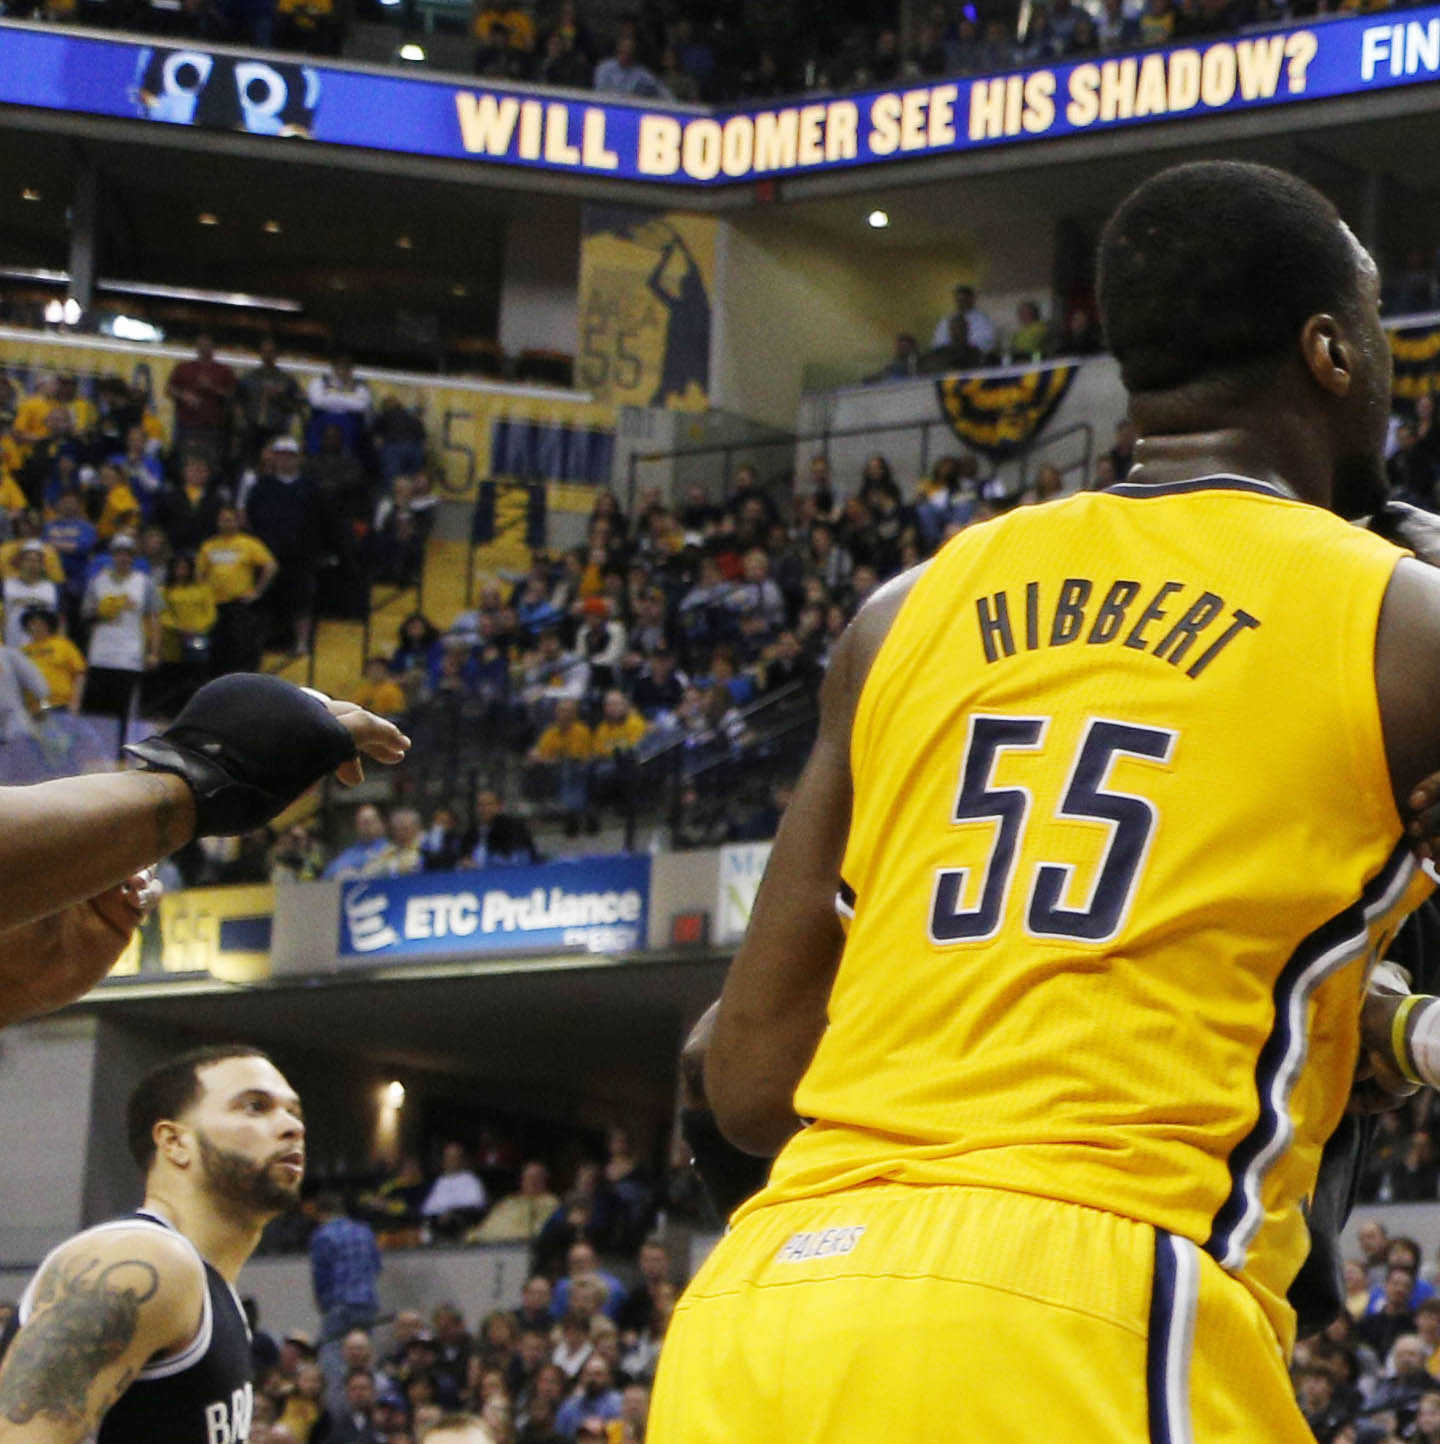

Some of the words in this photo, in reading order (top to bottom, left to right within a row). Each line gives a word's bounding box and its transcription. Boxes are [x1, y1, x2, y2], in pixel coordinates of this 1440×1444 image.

[456, 91, 619, 170] WILL
[637, 100, 859, 181] BOOMER
[869, 85, 958, 156] SEE
[968, 70, 1057, 142] HIS
[1066, 31, 1318, 127] SHADOW?
[976, 578, 1262, 681] HIBBERT
[928, 712, 1181, 944] 55
[404, 893, 478, 941] ETC
[482, 887, 642, 935] ProLiance
